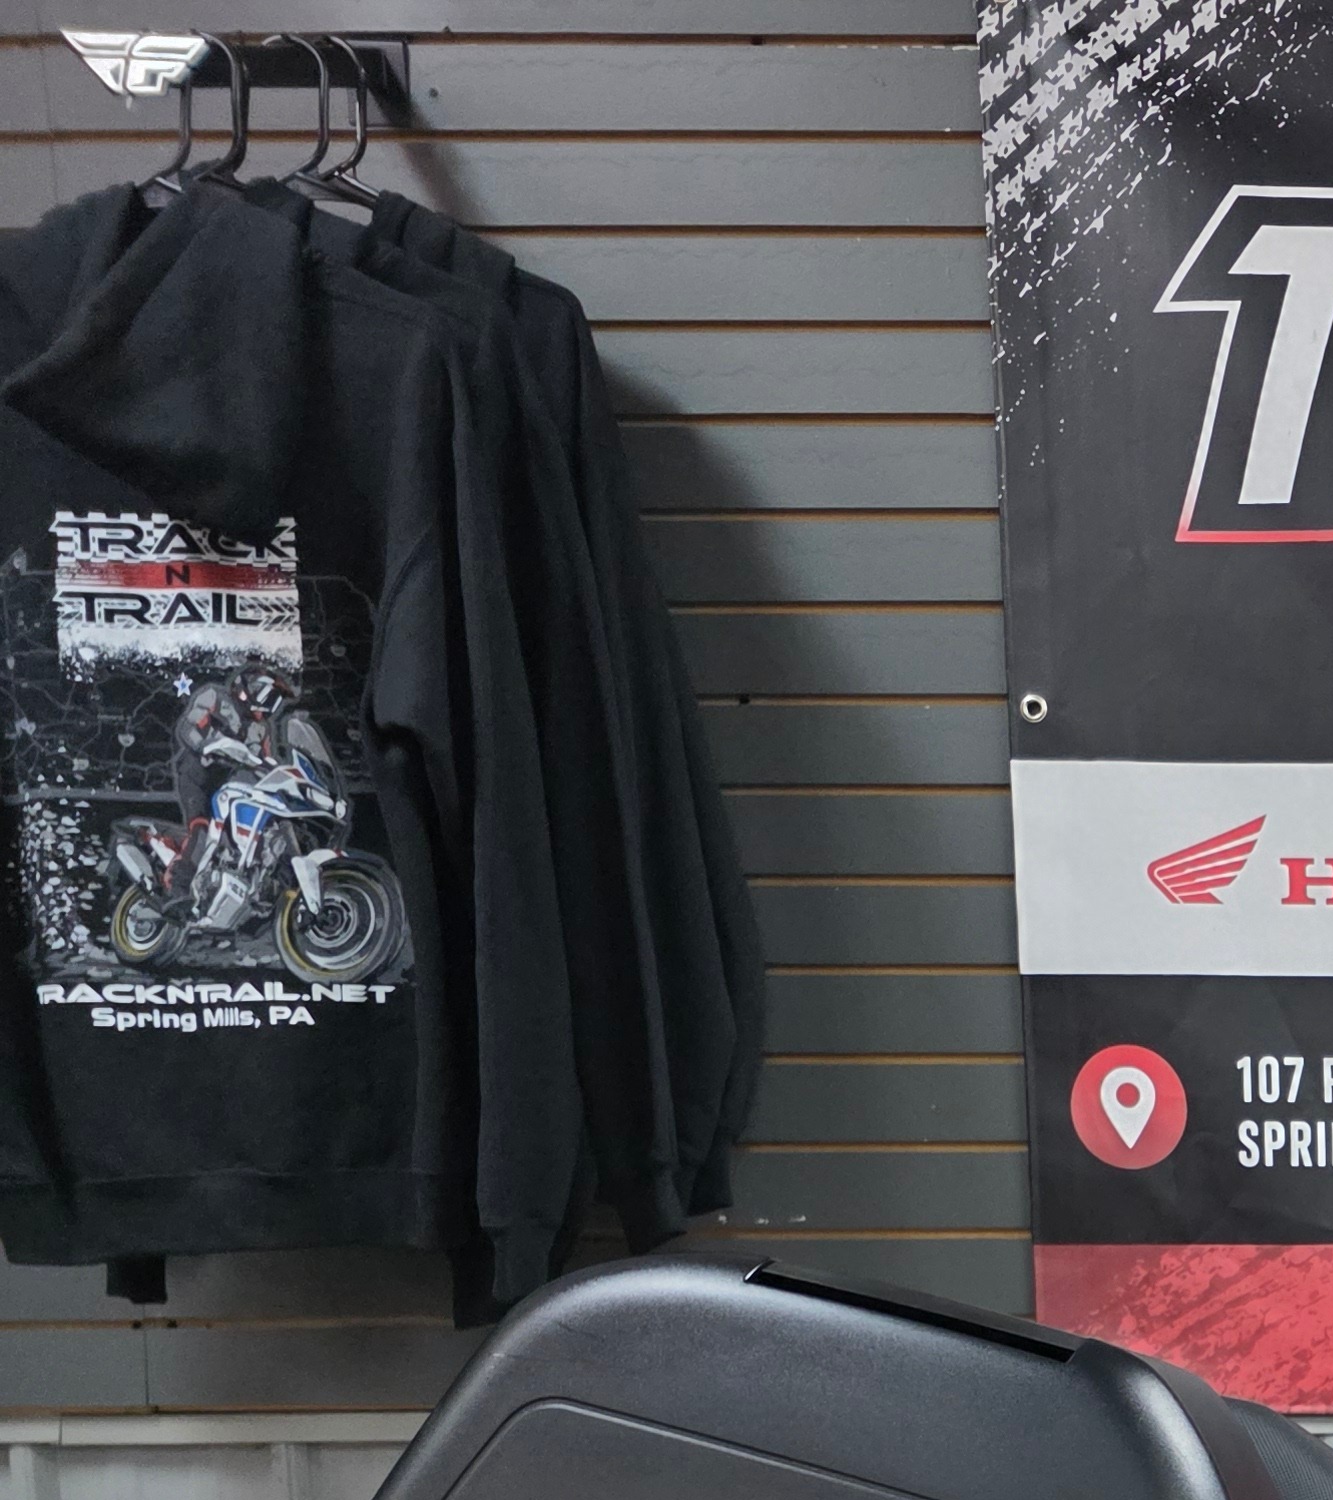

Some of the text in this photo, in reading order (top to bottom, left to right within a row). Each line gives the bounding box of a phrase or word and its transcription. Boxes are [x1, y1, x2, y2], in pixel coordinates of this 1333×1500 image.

[165, 564, 191, 586] N
[56, 590, 264, 625] TRAIL
[91, 1007, 197, 1032] Spring
[268, 1005, 316, 1026] PA
[1236, 1056, 1304, 1105] 107
